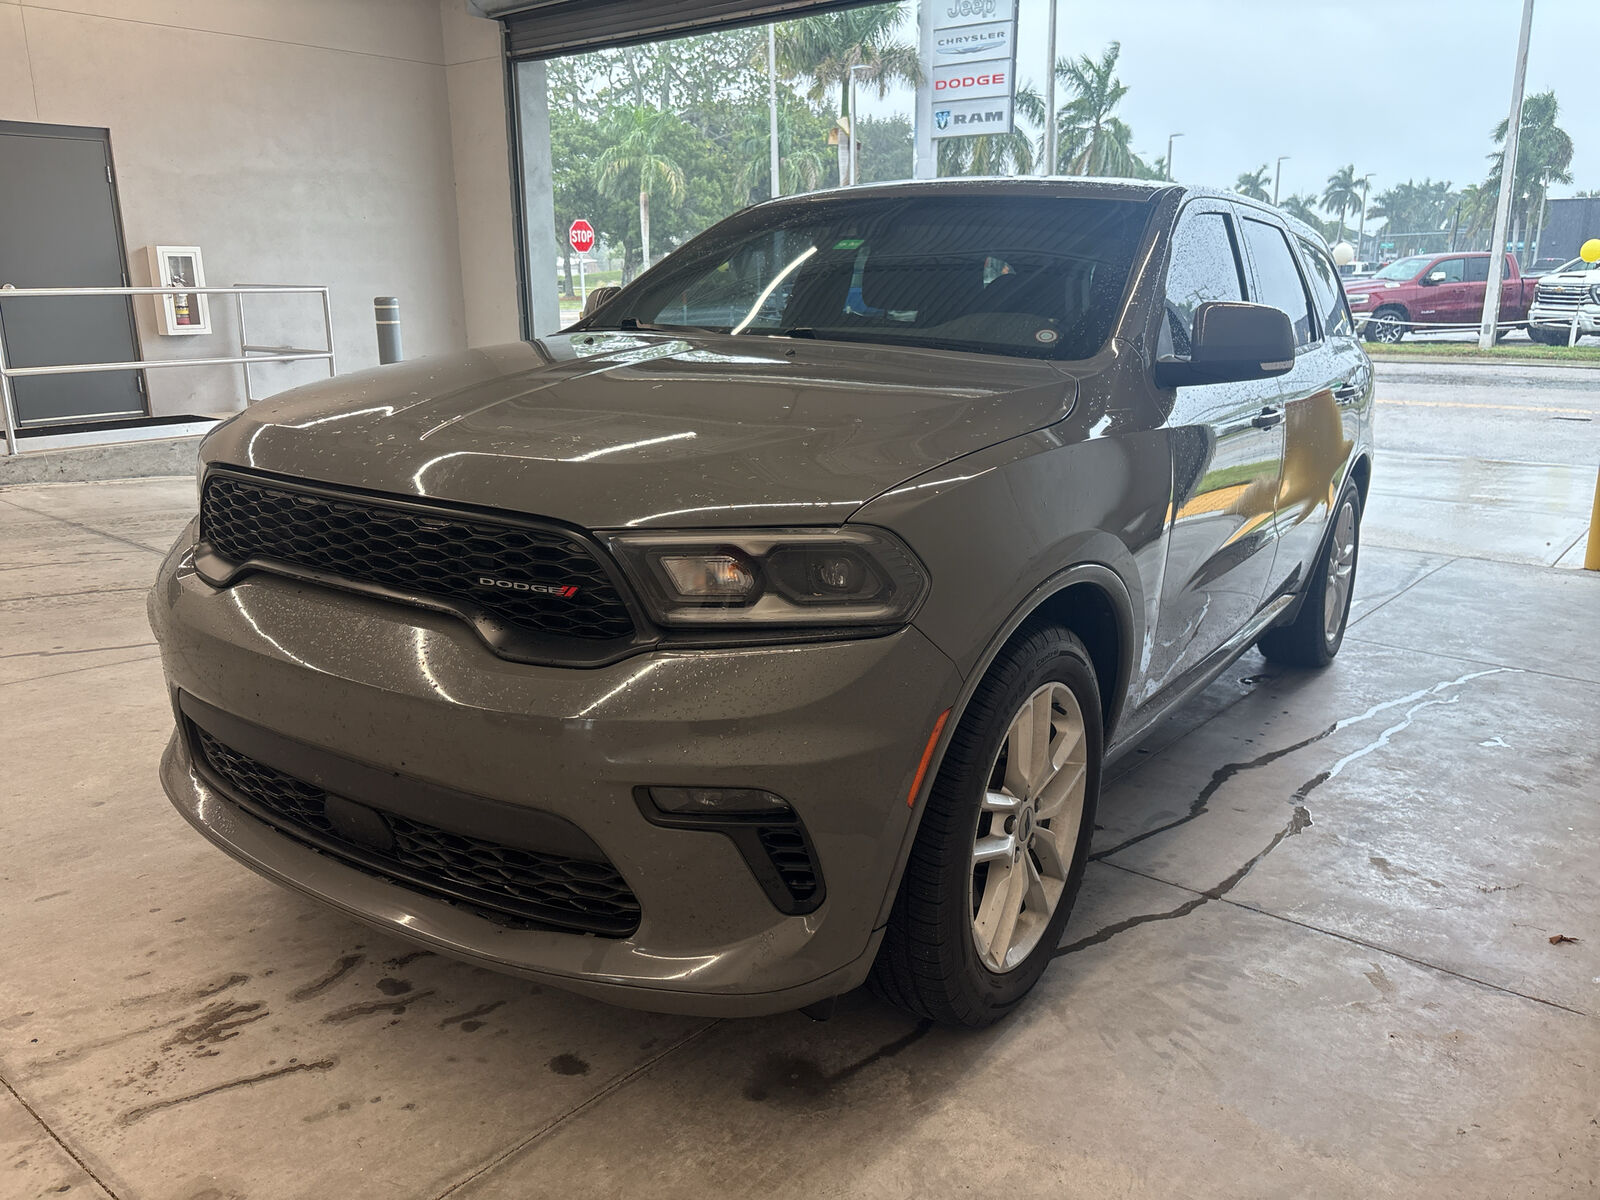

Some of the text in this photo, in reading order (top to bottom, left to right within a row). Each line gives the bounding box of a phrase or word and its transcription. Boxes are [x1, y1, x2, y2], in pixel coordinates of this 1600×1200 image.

[947, 0, 996, 18] Jeep
[937, 31, 1006, 46] CHRYSLER
[935, 73, 1005, 91] DODGE
[953, 111, 1003, 125] RAM
[571, 230, 592, 243] STOP
[479, 577, 565, 595] DODGE
